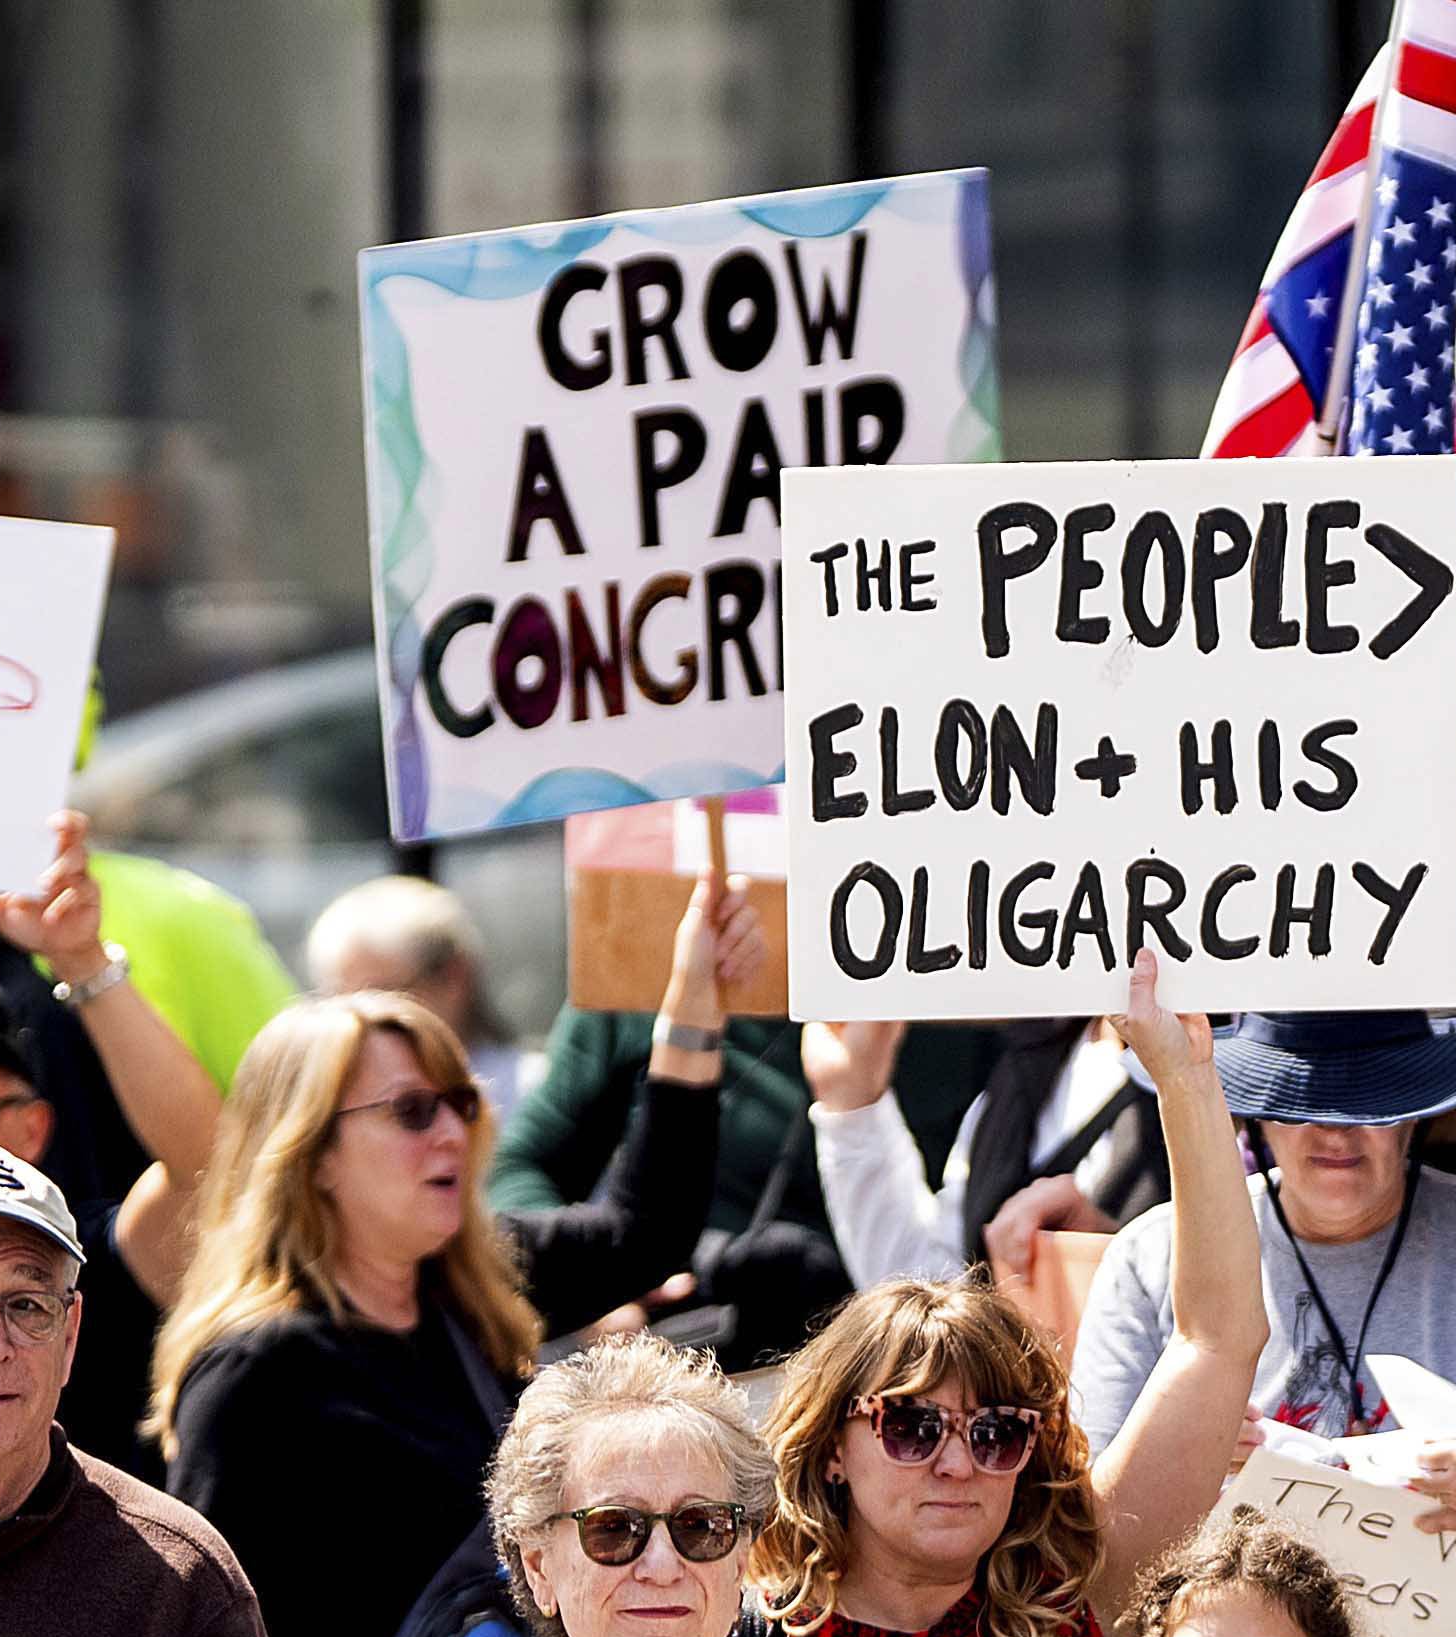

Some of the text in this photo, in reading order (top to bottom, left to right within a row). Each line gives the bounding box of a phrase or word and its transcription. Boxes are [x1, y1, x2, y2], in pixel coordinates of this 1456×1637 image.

[537, 230, 869, 391] GROW
[505, 425, 587, 563] A
[809, 538, 938, 618] THE
[419, 559, 784, 740] CONGR
[809, 698, 1058, 822] ELON
[1179, 716, 1359, 817] HIS
[830, 856, 1430, 982] OLIGARCHY
[1271, 1476, 1396, 1540] The
